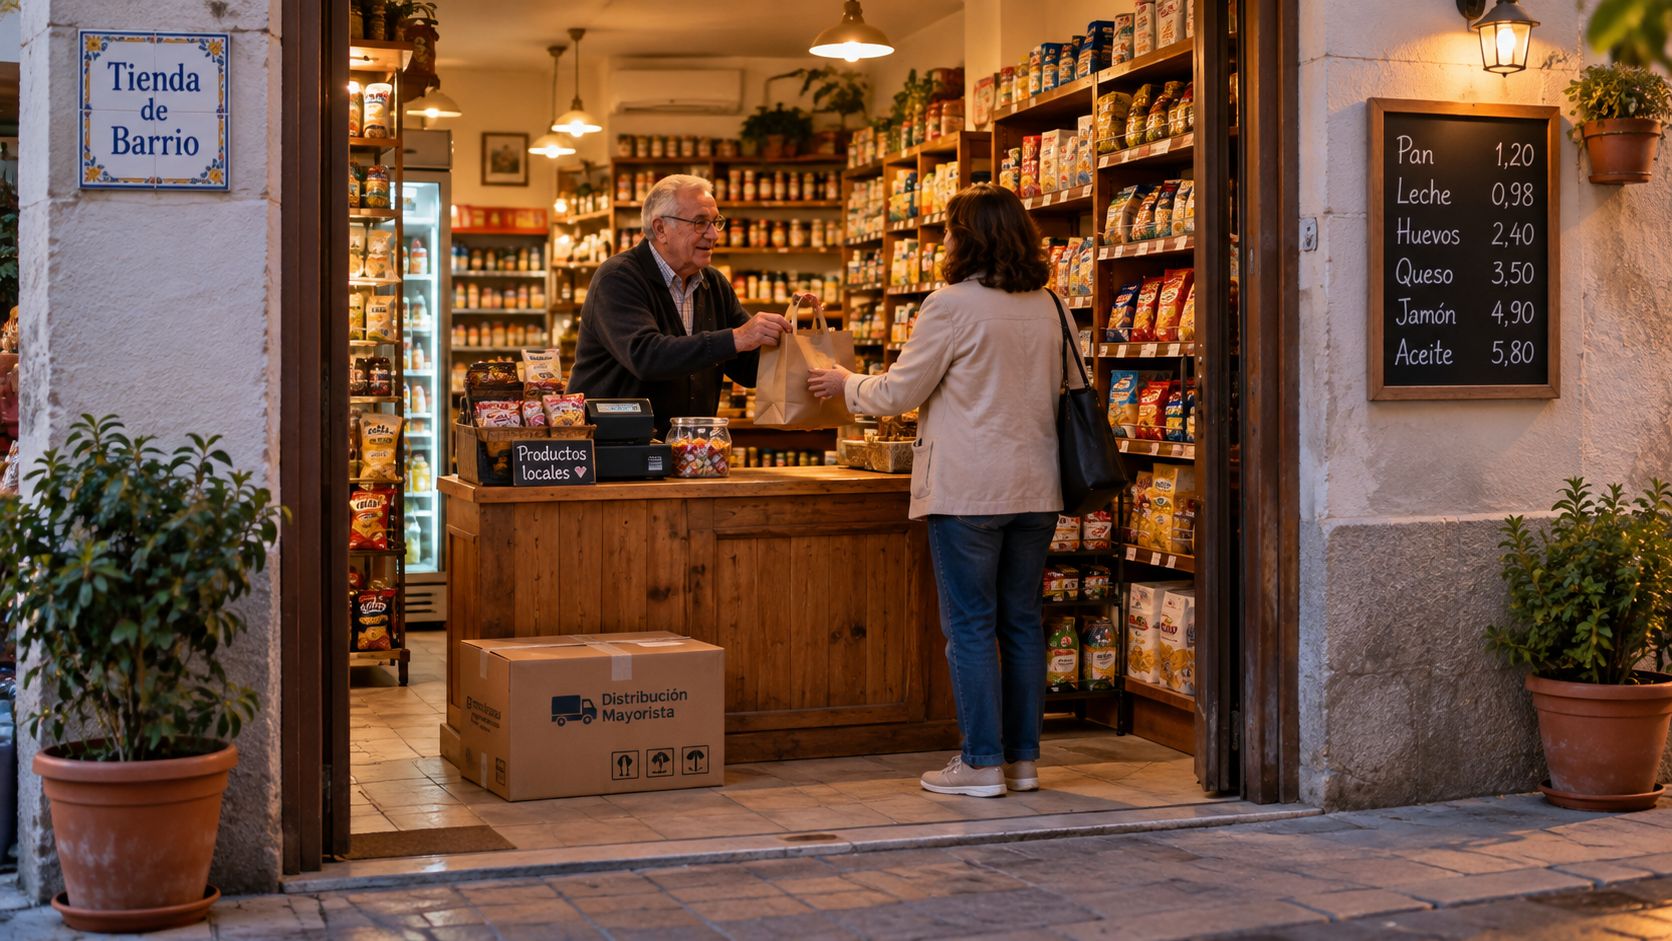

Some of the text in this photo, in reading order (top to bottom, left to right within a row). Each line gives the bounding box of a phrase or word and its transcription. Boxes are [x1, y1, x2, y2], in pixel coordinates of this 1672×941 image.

[107, 62, 201, 92] Tienda
[141, 97, 168, 121] de
[111, 126, 200, 156] Barrio
[1396, 135, 1535, 169] Pan 1,20
[1397, 177, 1534, 209] Leche 0,98
[1397, 217, 1535, 247] Huevos 2,40
[1396, 257, 1535, 287] Queso 3,50
[1396, 297, 1535, 327] Jamón 4,90
[1395, 338, 1535, 367] Aceite 5,80
[517, 445, 587, 464] Productos
[522, 464, 570, 481] locales
[602, 688, 688, 706] Distribución
[602, 706, 675, 725] Mayorista
